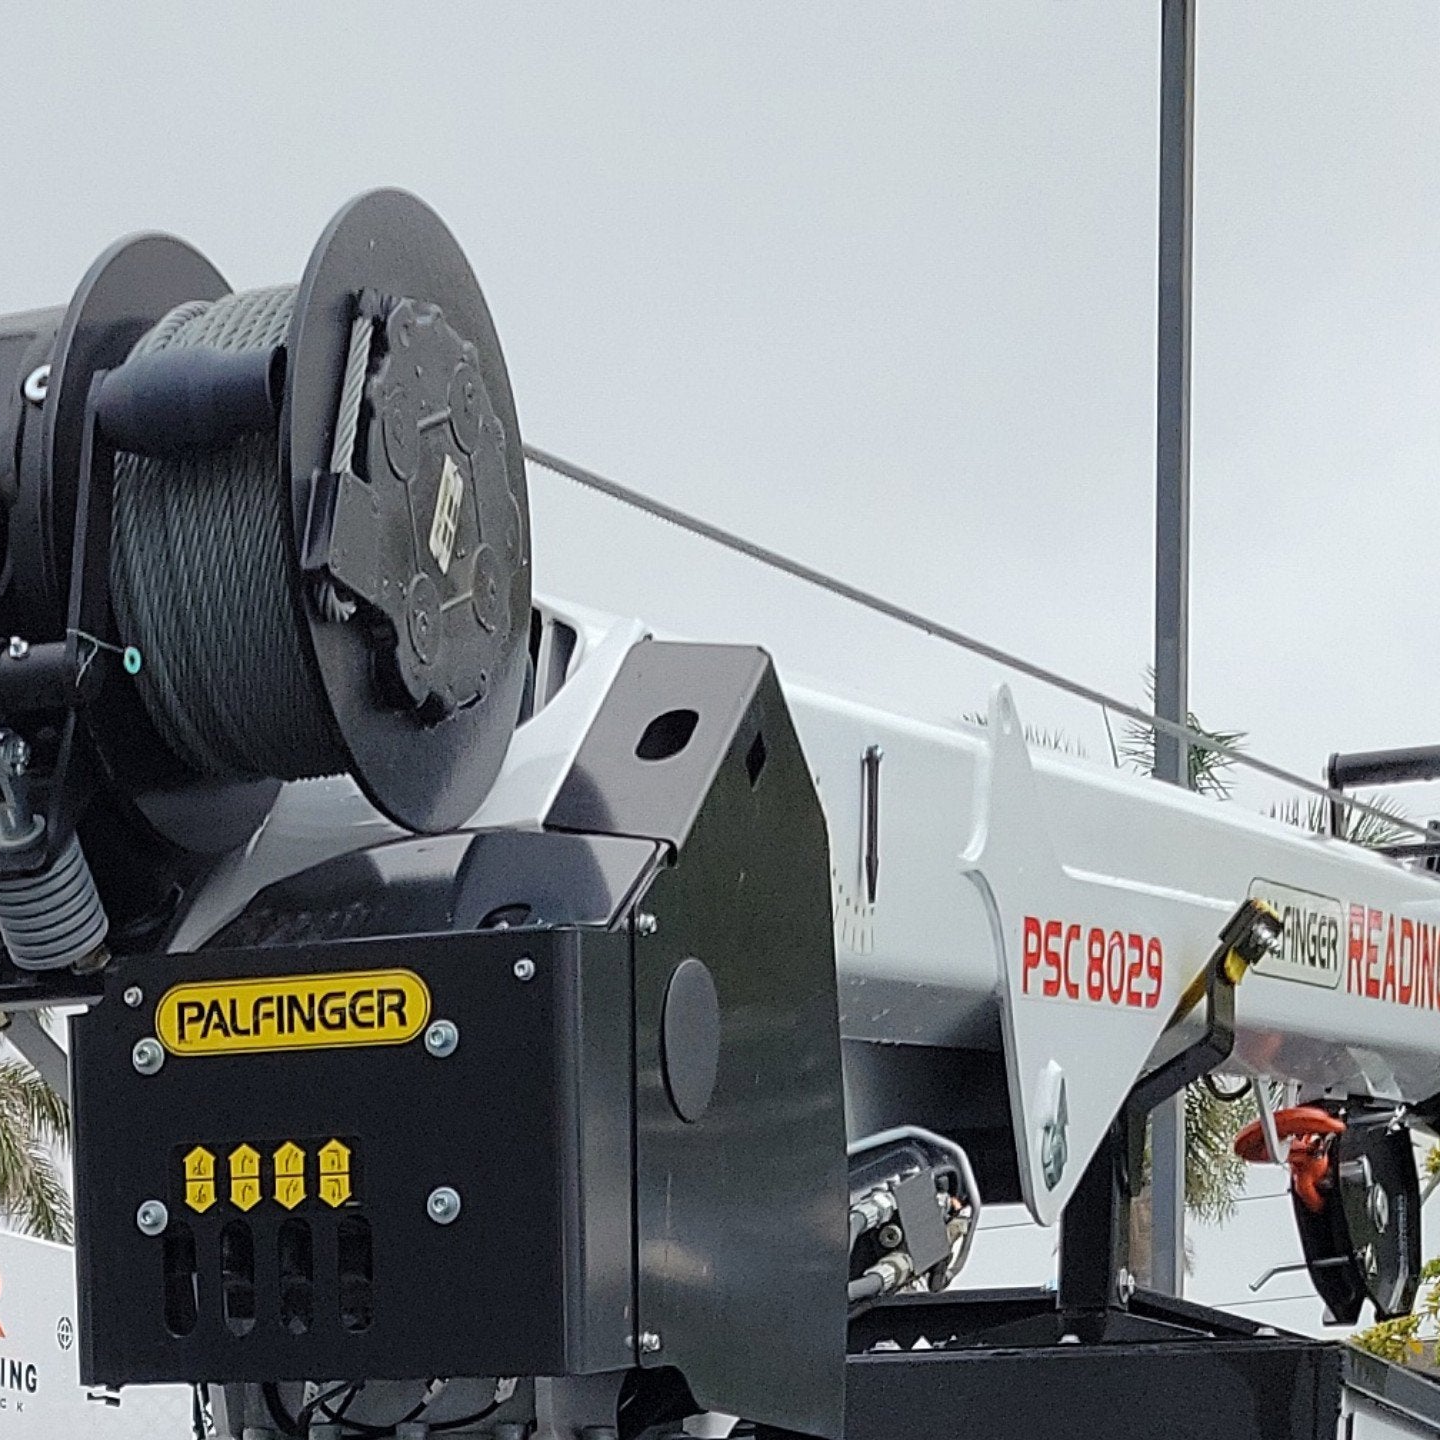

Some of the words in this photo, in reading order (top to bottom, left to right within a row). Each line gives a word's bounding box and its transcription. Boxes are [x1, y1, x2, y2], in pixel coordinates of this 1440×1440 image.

[1022, 916, 1081, 999] PSC
[1087, 928, 1162, 1009] 8029
[176, 988, 408, 1043] PALFINGER
